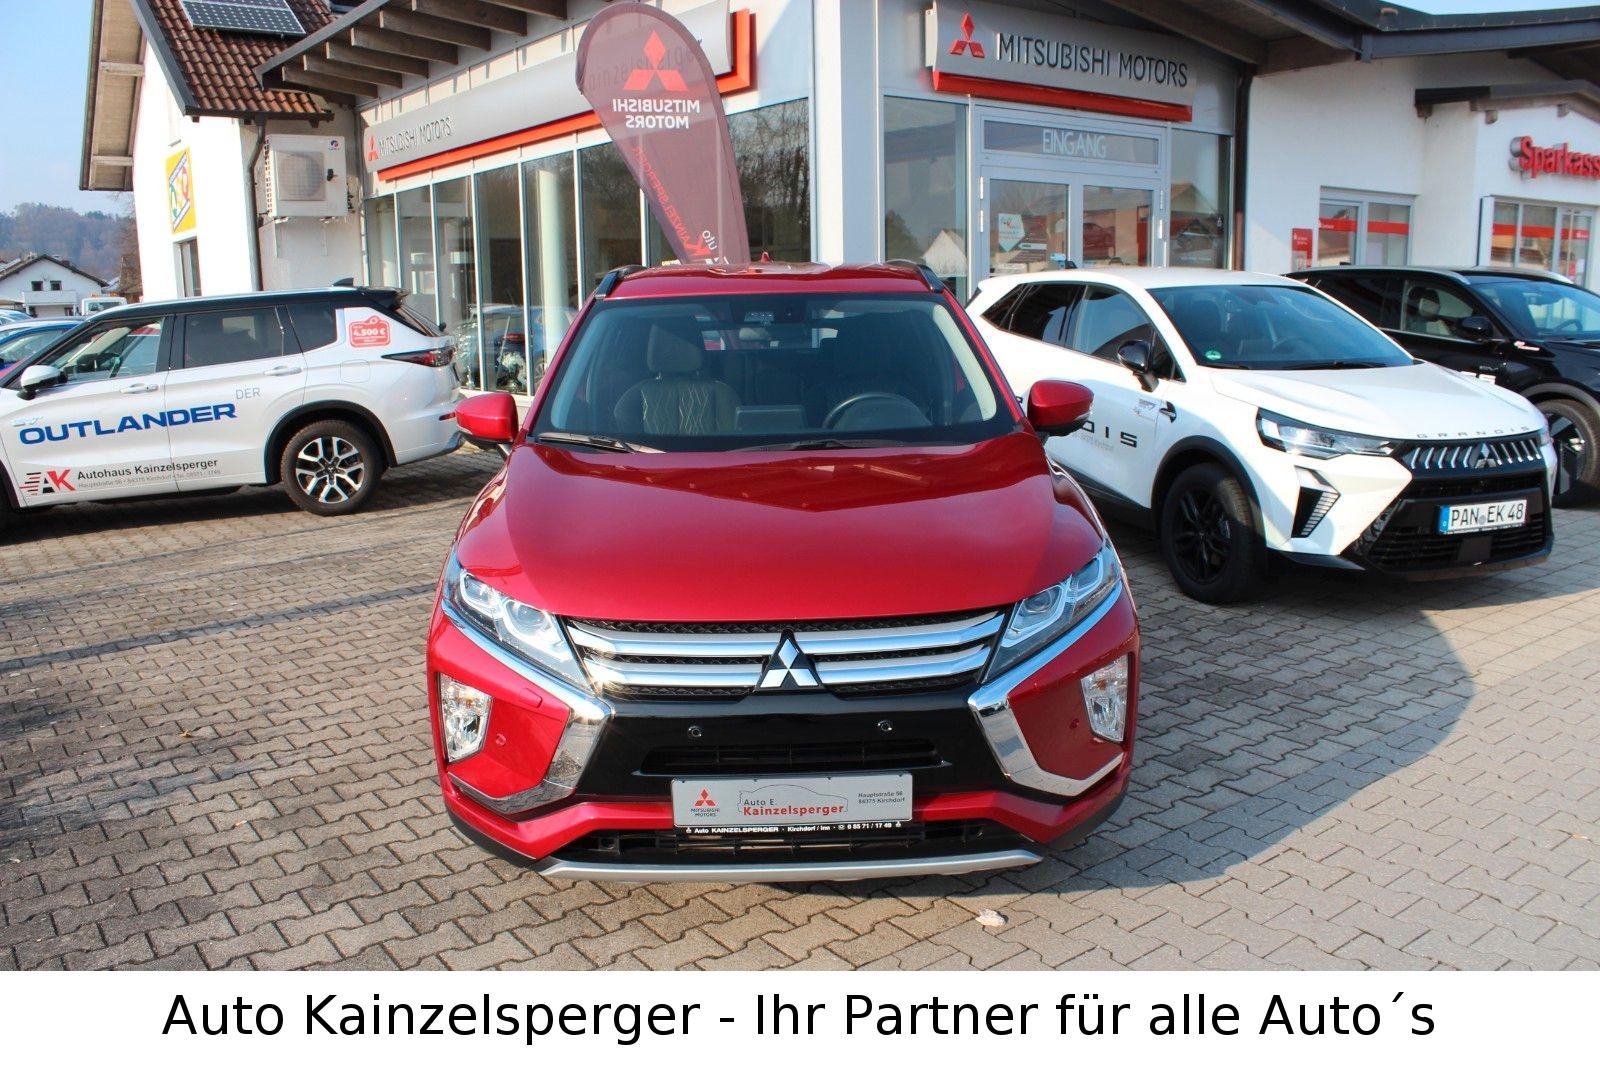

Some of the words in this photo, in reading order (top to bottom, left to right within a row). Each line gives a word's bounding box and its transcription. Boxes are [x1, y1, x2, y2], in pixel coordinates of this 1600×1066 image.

[995, 31, 1110, 76] MITSUBISHI
[1118, 51, 1188, 88] MOTORS
[379, 127, 418, 156] MITSUBISHI
[420, 116, 453, 143] MOTORS
[1042, 128, 1106, 159] EINGANG
[353, 328, 379, 337] 4.500
[235, 387, 261, 400] DER
[19, 402, 238, 446] OUTLANDER
[77, 467, 132, 481] Autohaus
[134, 459, 219, 475] Kainzelsperger
[1451, 508, 1480, 526] PAN
[1487, 505, 1504, 523] EK
[1507, 503, 1525, 520] 48
[743, 798, 767, 806] Auto
[743, 805, 845, 817] Kainzelsperger
[787, 824, 816, 832] Kirchdorf
